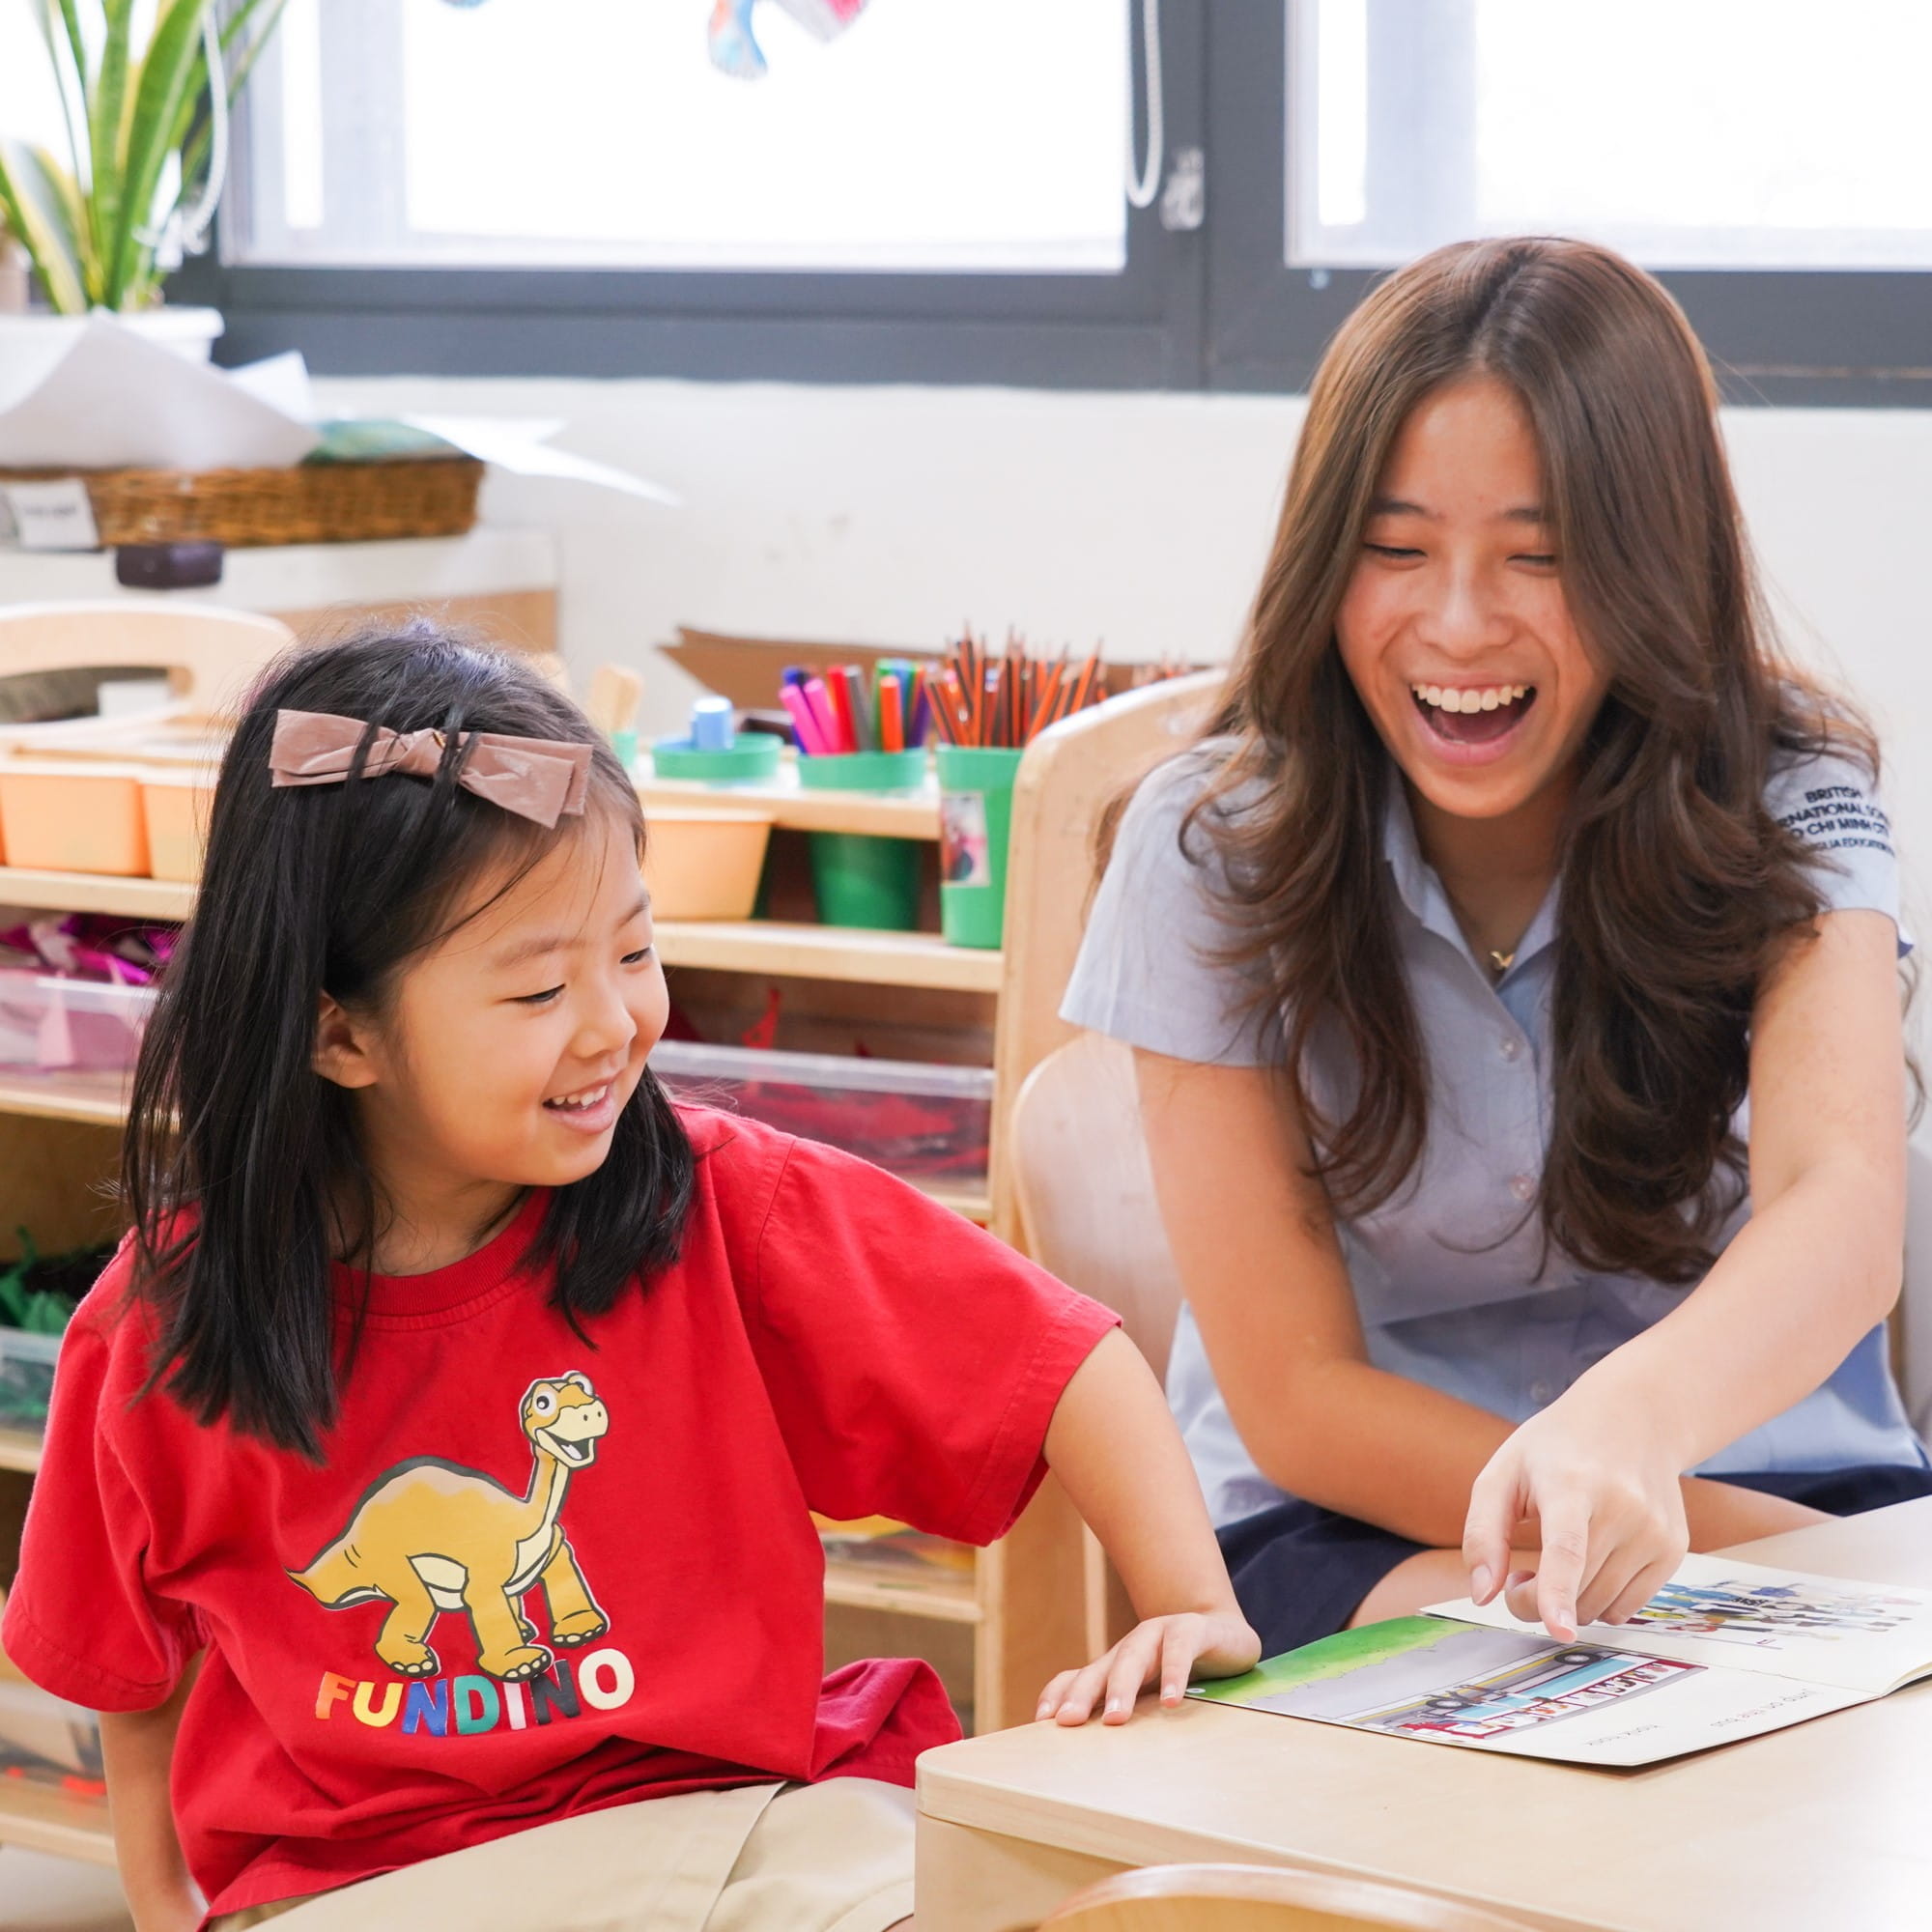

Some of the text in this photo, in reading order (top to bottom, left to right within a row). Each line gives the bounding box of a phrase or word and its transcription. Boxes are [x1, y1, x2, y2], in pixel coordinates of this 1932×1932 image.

[1804, 786, 1862, 804] BRITISH
[1806, 820, 1834, 836] CHI
[1837, 818, 1871, 832] MINH
[315, 1648, 635, 1737] FUNDINO
